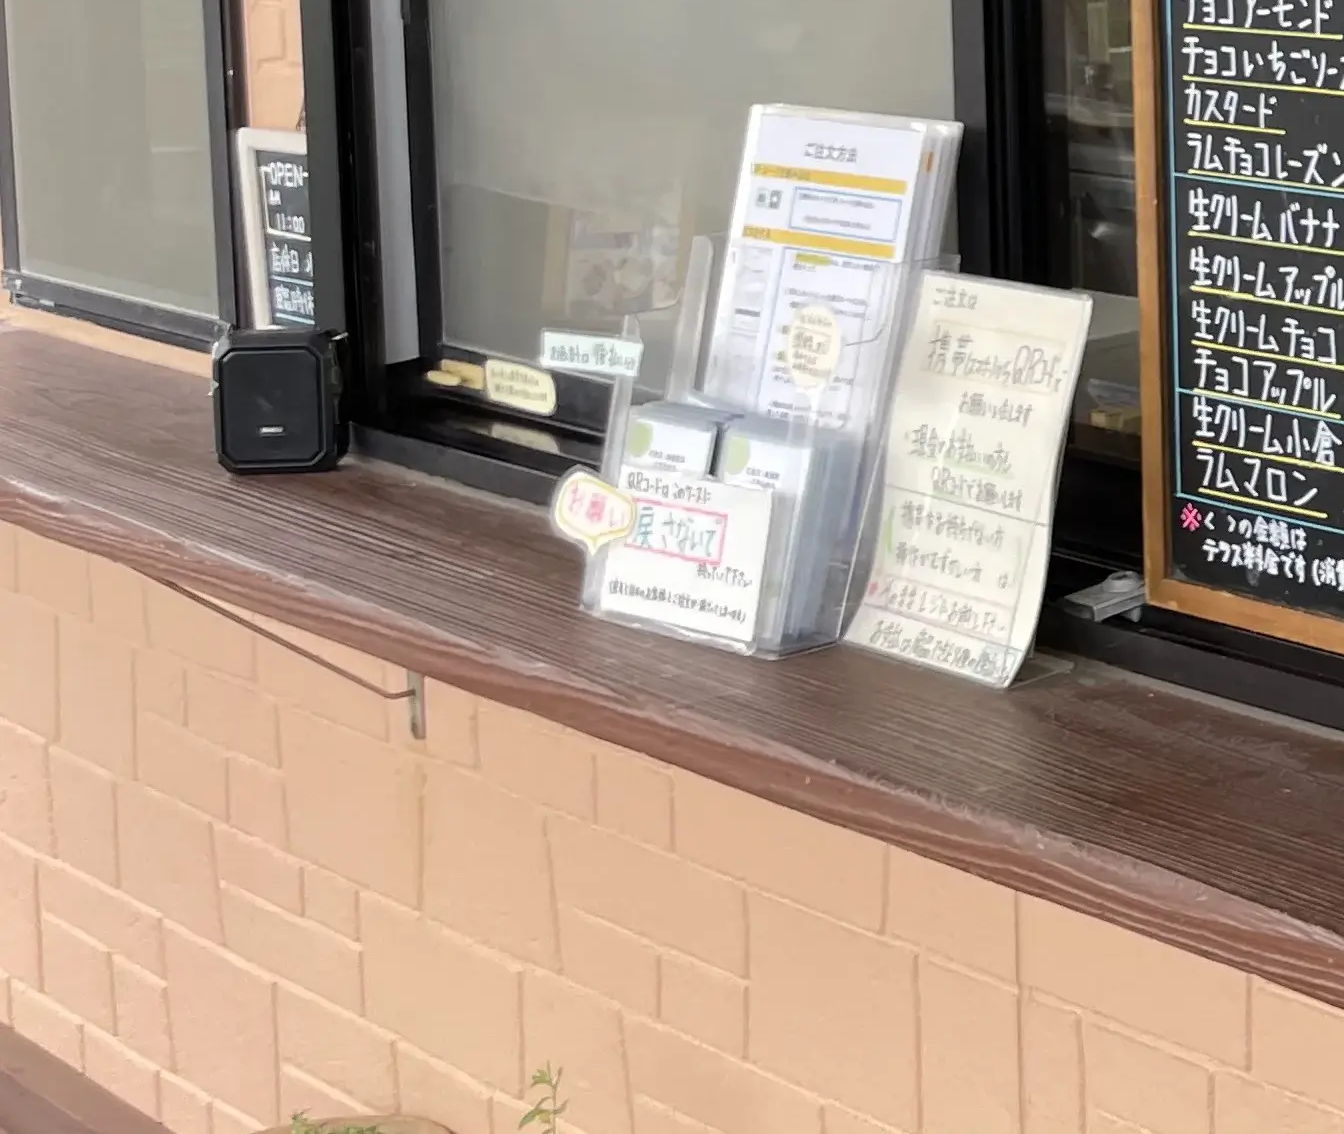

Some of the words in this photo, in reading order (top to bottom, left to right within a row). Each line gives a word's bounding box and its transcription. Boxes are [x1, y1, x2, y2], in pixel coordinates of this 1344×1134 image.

[1185, 82, 1277, 128] カスタード
[1188, 187, 1339, 248] 生クリームバナナ
[1192, 299, 1336, 364] 生クリームチョコ
[1194, 348, 1336, 412] チョコアップル
[1193, 396, 1342, 466] 生クリーム小倉
[1196, 448, 1319, 505] ラムマロン
